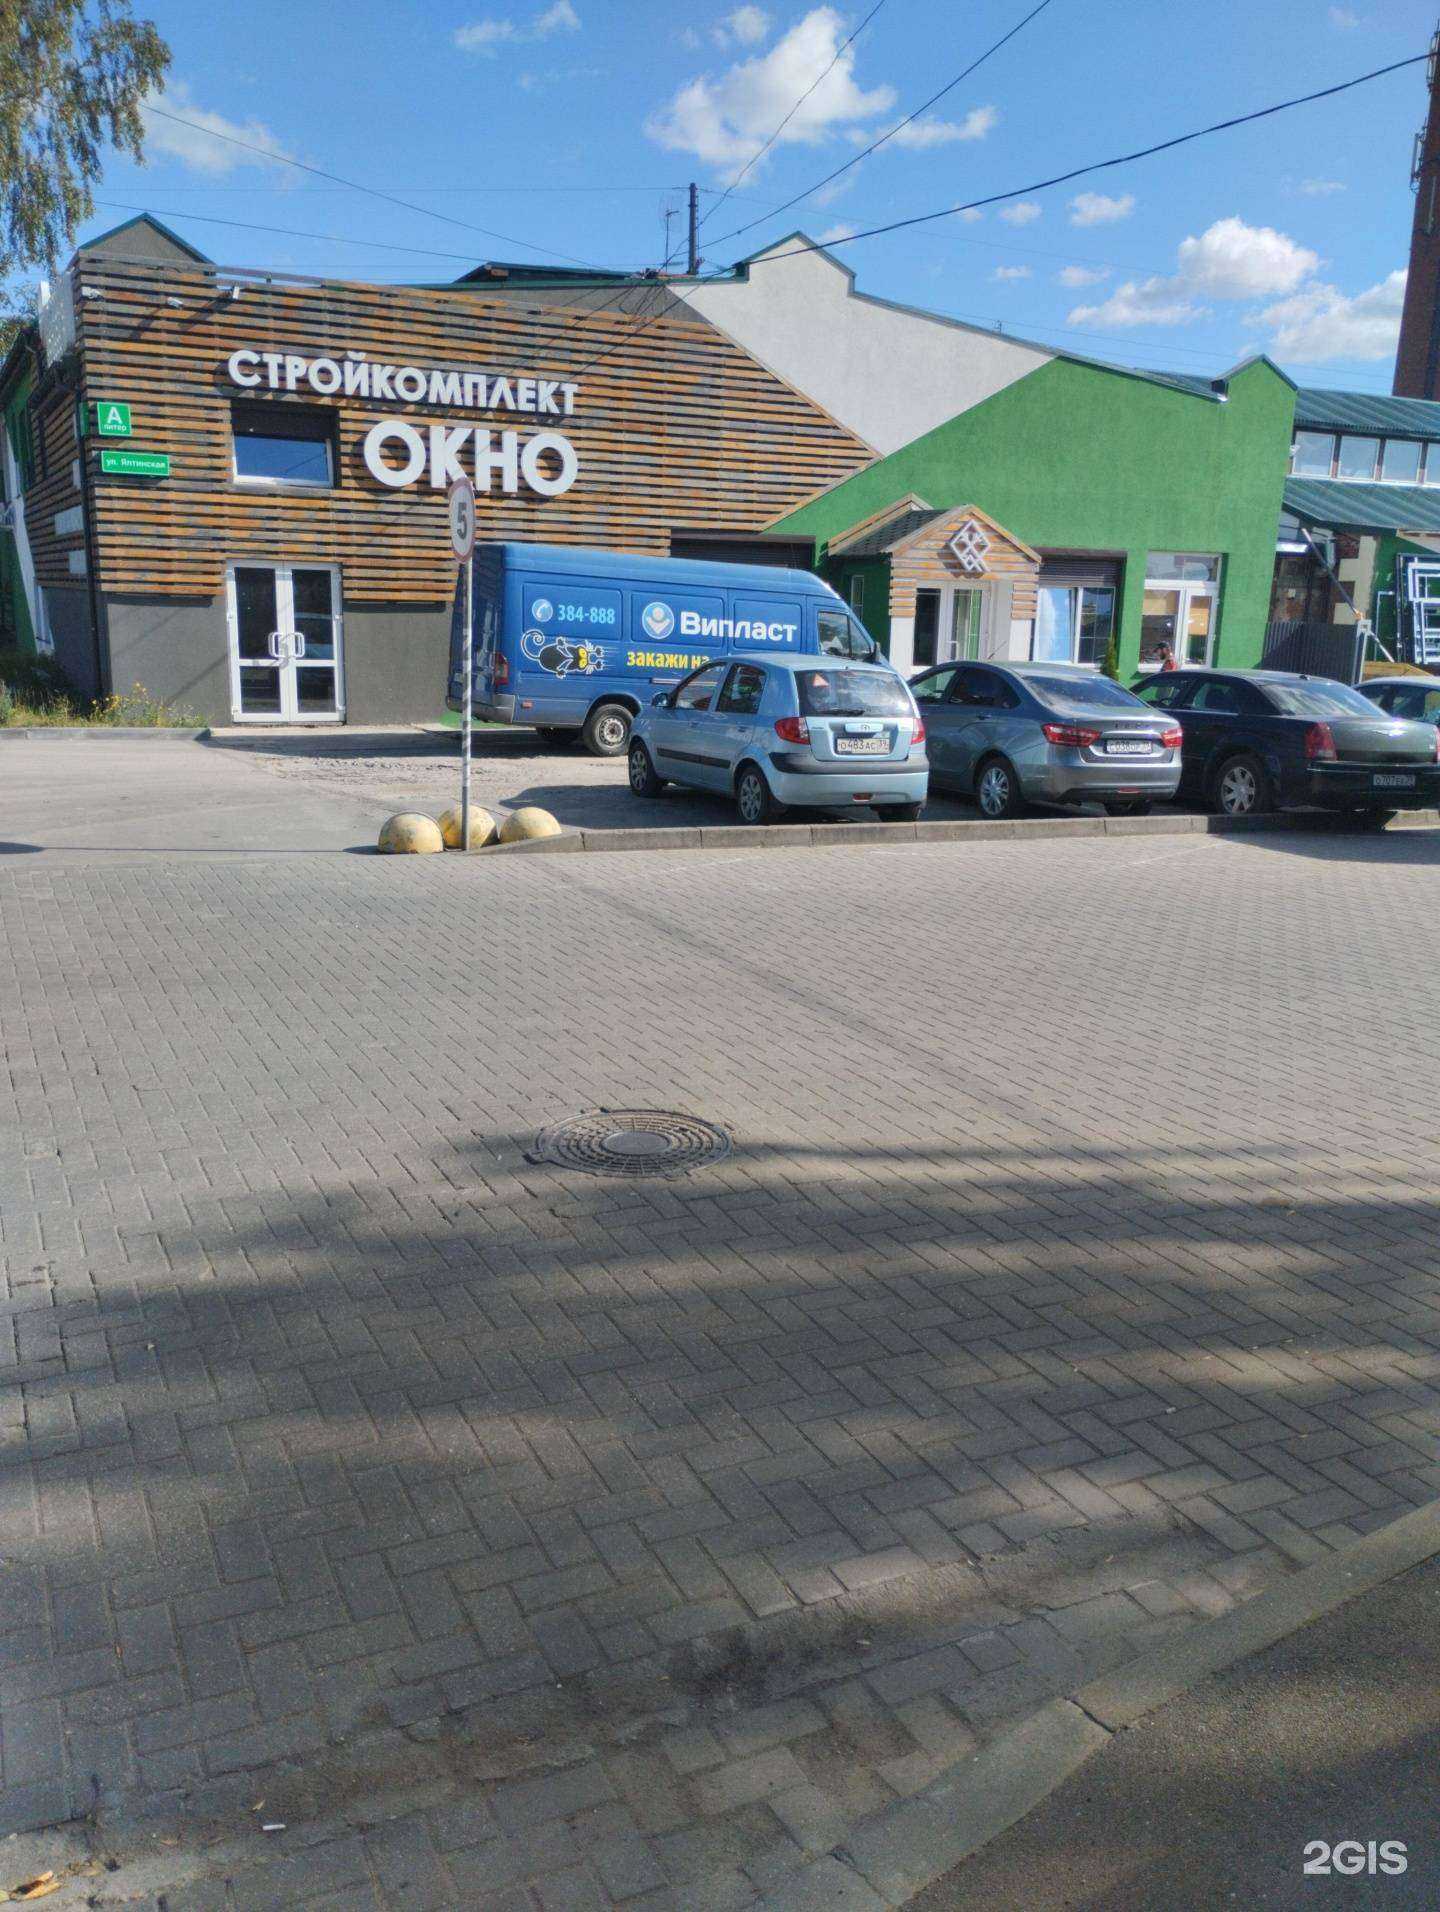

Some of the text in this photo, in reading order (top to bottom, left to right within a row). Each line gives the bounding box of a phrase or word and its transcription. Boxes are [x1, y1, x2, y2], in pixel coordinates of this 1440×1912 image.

[228, 350, 579, 415] СТРОЙКОМПЛЕКТ
[107, 407, 123, 424] А
[364, 420, 579, 497] ОКНО
[457, 502, 467, 539] 5
[558, 604, 615, 624] 384-888
[680, 611, 798, 642] Випласт
[626, 651, 688, 669] закажи
